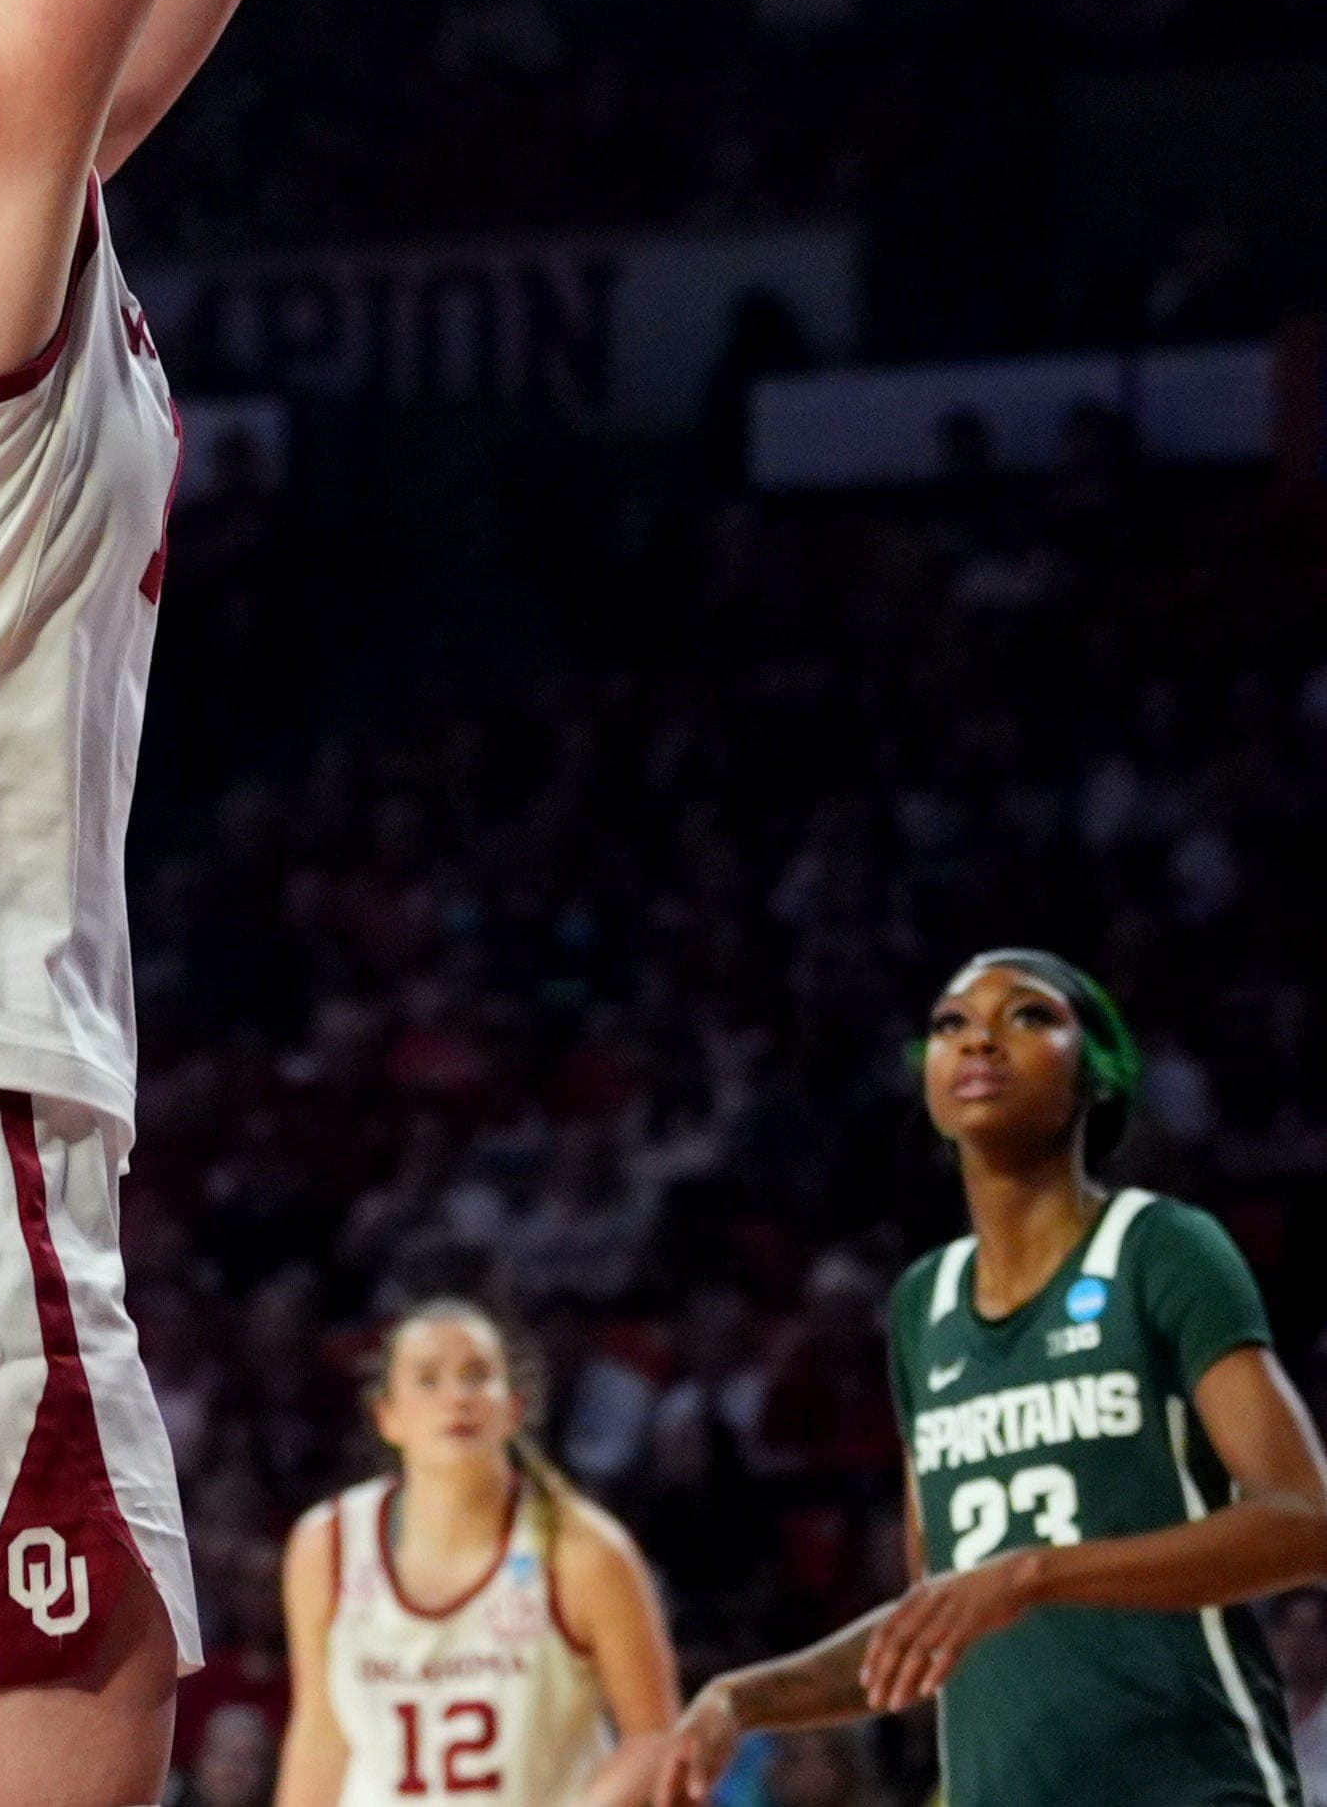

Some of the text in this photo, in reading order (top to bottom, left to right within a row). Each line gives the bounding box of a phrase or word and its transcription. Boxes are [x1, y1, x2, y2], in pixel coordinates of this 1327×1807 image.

[915, 1371, 1143, 1476] SPARTANS
[950, 1464, 1083, 1572] 23
[7, 1525, 91, 1637] OU
[394, 1701, 502, 1795] 12
